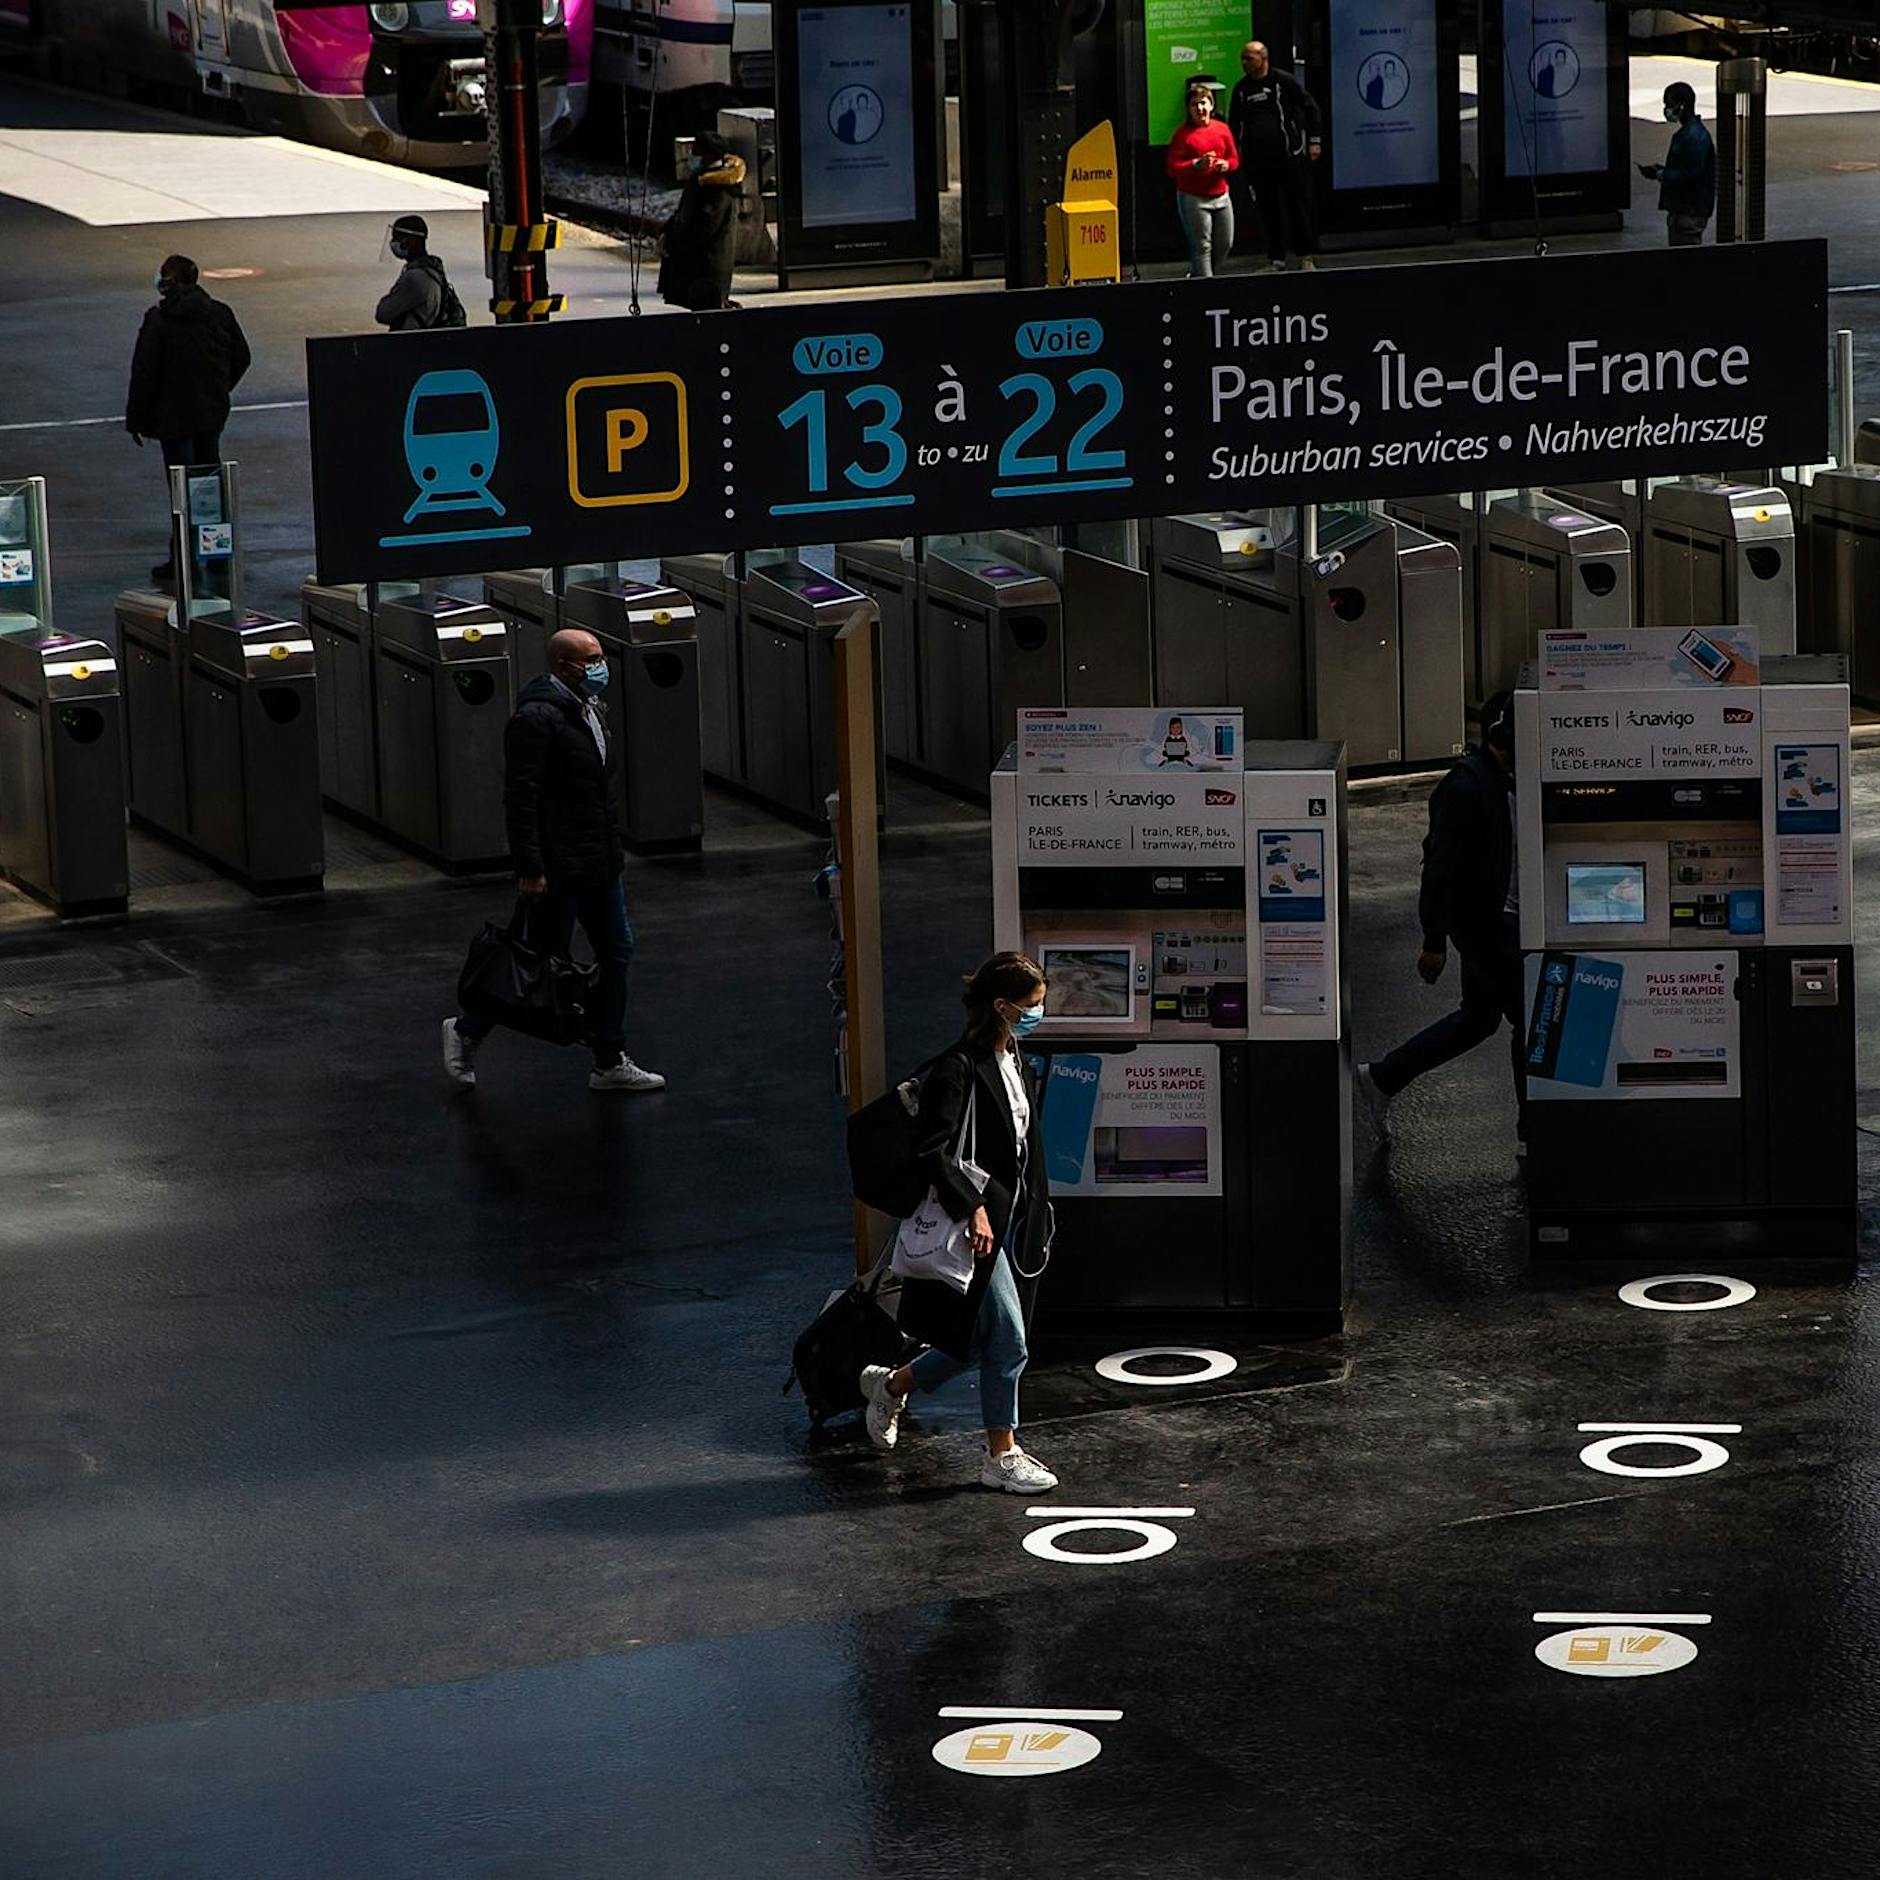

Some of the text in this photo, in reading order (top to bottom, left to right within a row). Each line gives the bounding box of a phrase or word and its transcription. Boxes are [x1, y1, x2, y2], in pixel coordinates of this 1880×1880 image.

[1071, 168, 1113, 182] Alarme
[1080, 224, 1106, 245] 7106
[1205, 304, 1329, 348] Trains
[1027, 324, 1090, 353] Voie
[805, 340, 871, 369] Voie
[1211, 338, 1750, 426] Paris, Île-de-France
[777, 364, 1126, 492] 13 à 22
[917, 442, 989, 466] to zu
[1208, 413, 1768, 481] Suburban services Nahverkehrszug
[1551, 716, 1609, 729] TICKETS
[1636, 711, 1694, 730] navigo
[1552, 747, 1585, 757] PARIS
[1662, 743, 1748, 756] train, RER, bus,
[1662, 756, 1753, 770] tramway, métro
[1027, 794, 1088, 807] TICKETS
[1114, 791, 1175, 810] navigo
[1028, 826, 1063, 837] PARIS
[1142, 826, 1230, 838] train, RER, bus,
[1142, 837, 1236, 851] tramway, métro
[1575, 972, 1619, 991] navigo
[1646, 974, 1675, 984] PLUS
[1649, 986, 1725, 996] PLUS RAPIDE
[1051, 1063, 1098, 1084] navigo
[1125, 1067, 1205, 1078] PLUS SIMPLE,
[1128, 1080, 1205, 1090] PLUS RAPIDE
